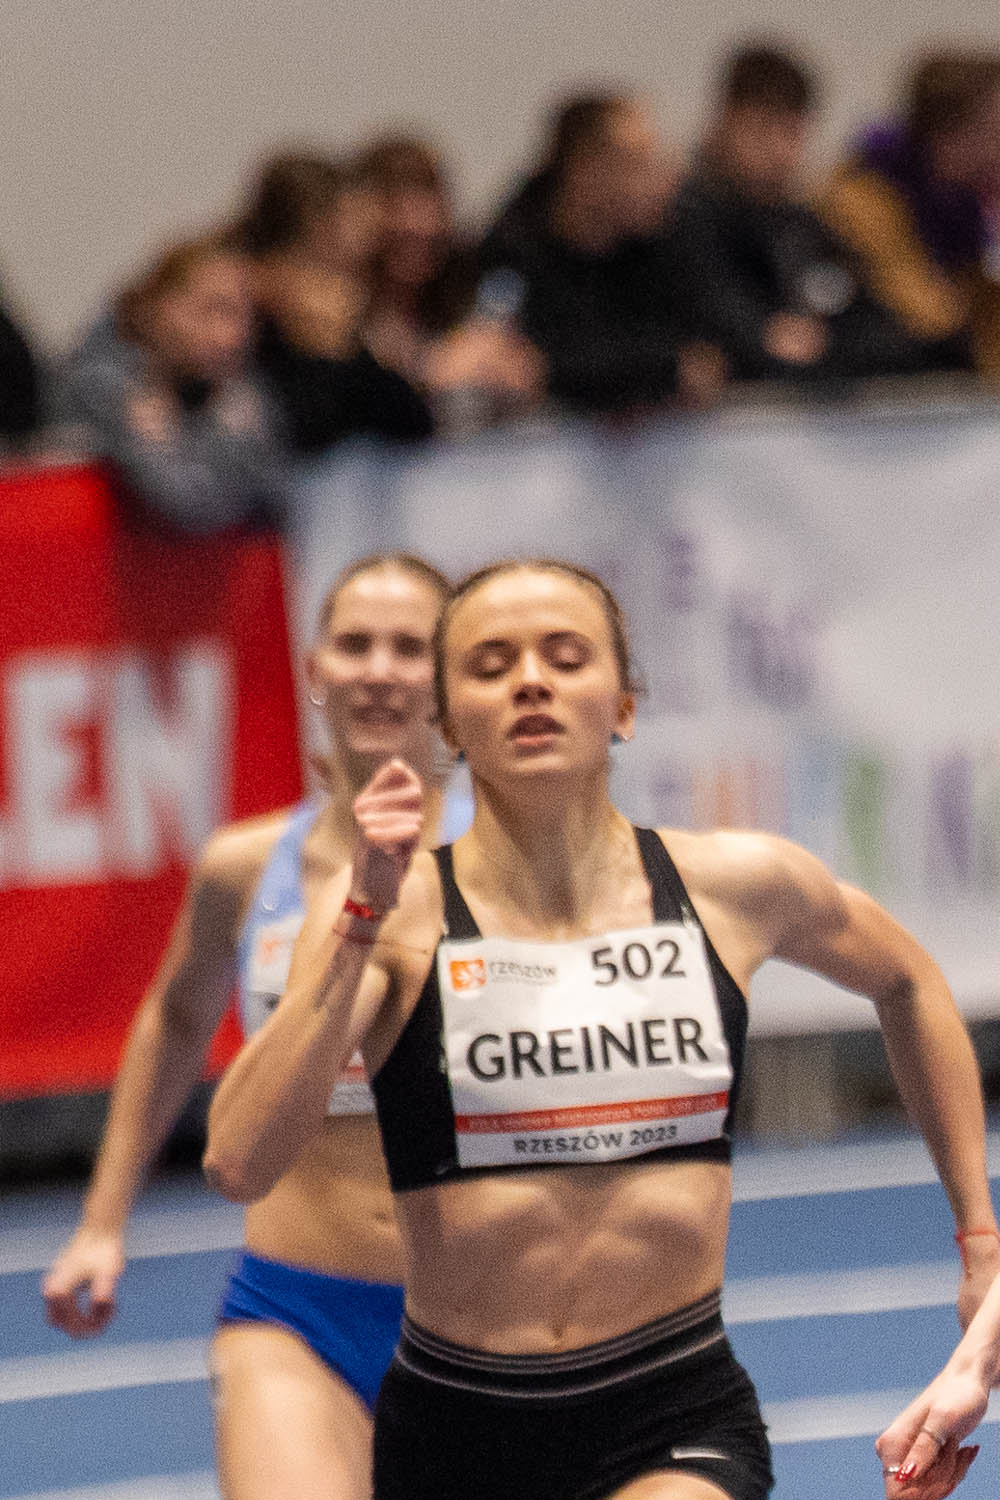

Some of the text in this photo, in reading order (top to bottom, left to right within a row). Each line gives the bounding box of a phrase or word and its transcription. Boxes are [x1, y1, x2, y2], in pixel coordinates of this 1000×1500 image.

[0, 650, 235, 878] EN
[591, 939, 686, 987] 502
[465, 1016, 711, 1083] GREINER
[513, 1125, 678, 1154] RZESZÓW 2023
